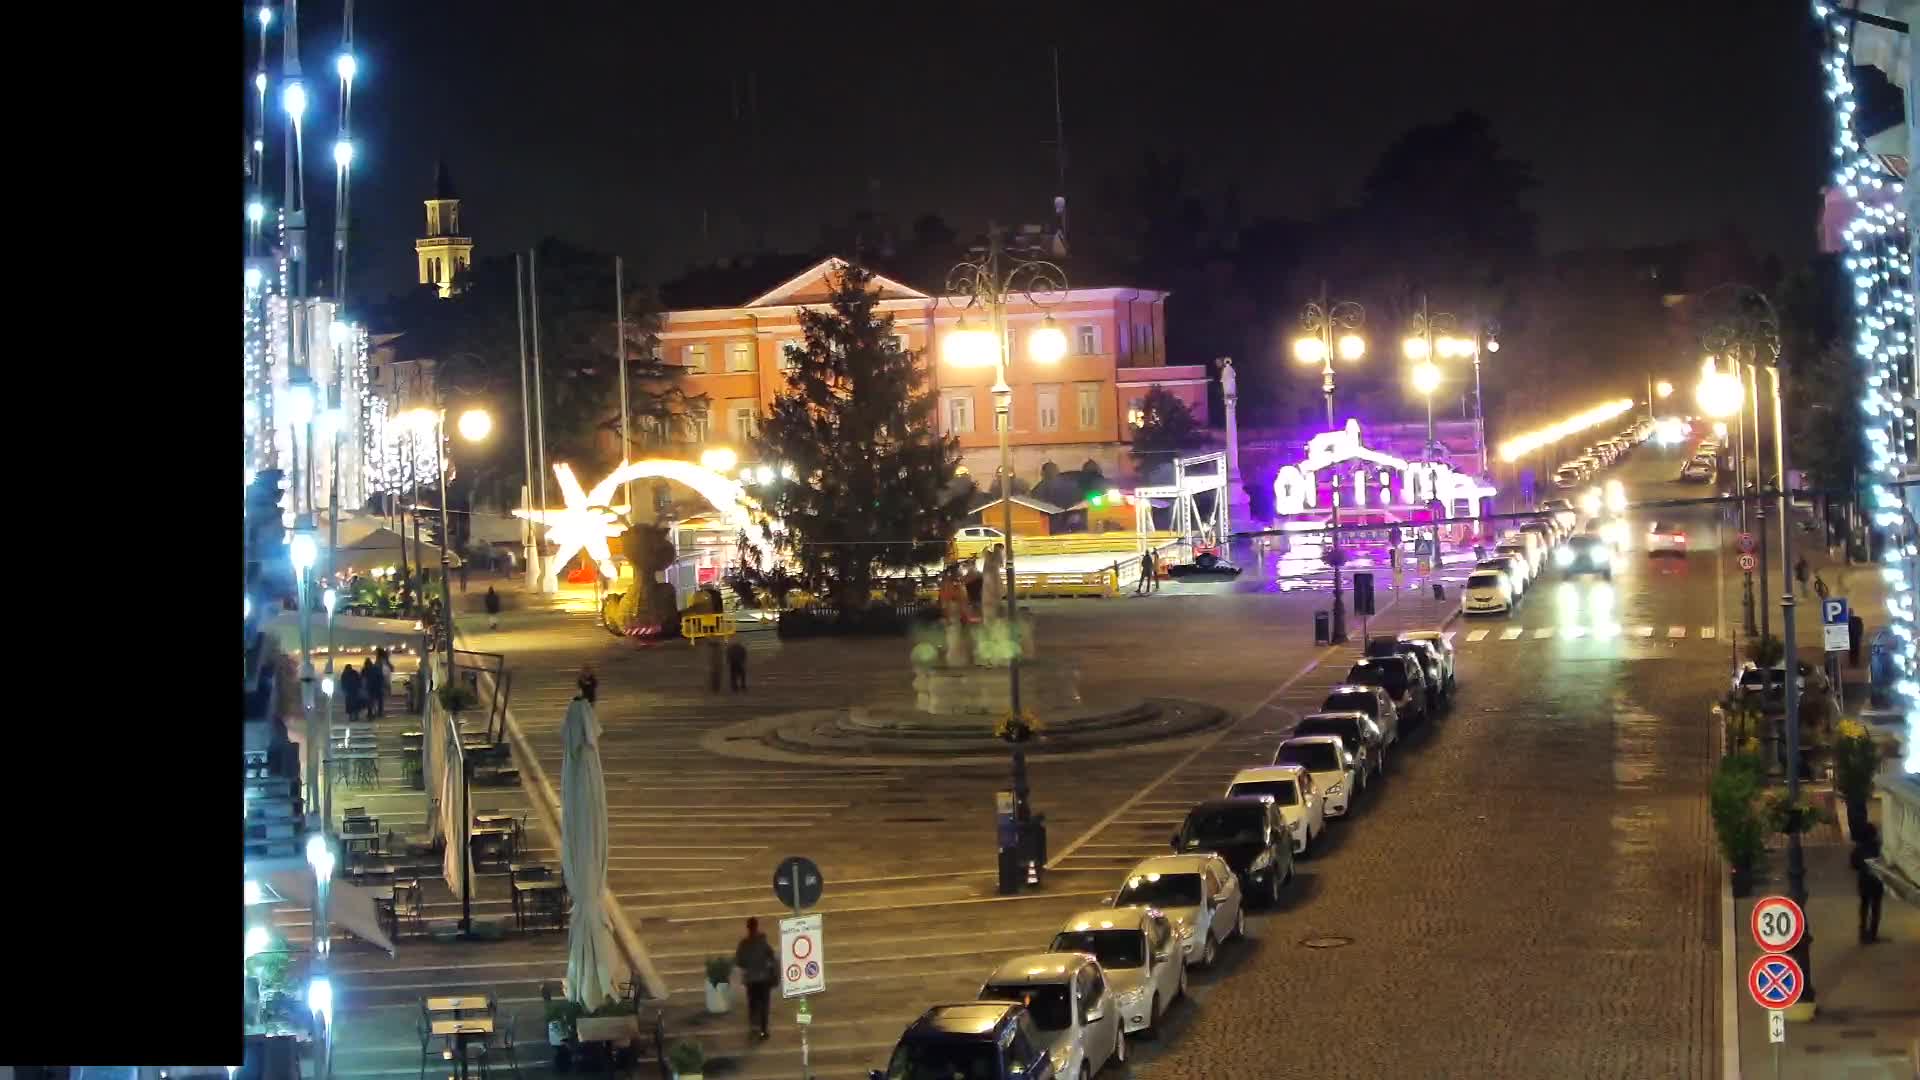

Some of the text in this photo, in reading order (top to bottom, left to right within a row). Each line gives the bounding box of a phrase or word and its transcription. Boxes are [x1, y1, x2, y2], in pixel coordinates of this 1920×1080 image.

[1742, 557, 1752, 566] 20
[1826, 602, 1842, 622] P
[1762, 912, 1791, 937] 30
